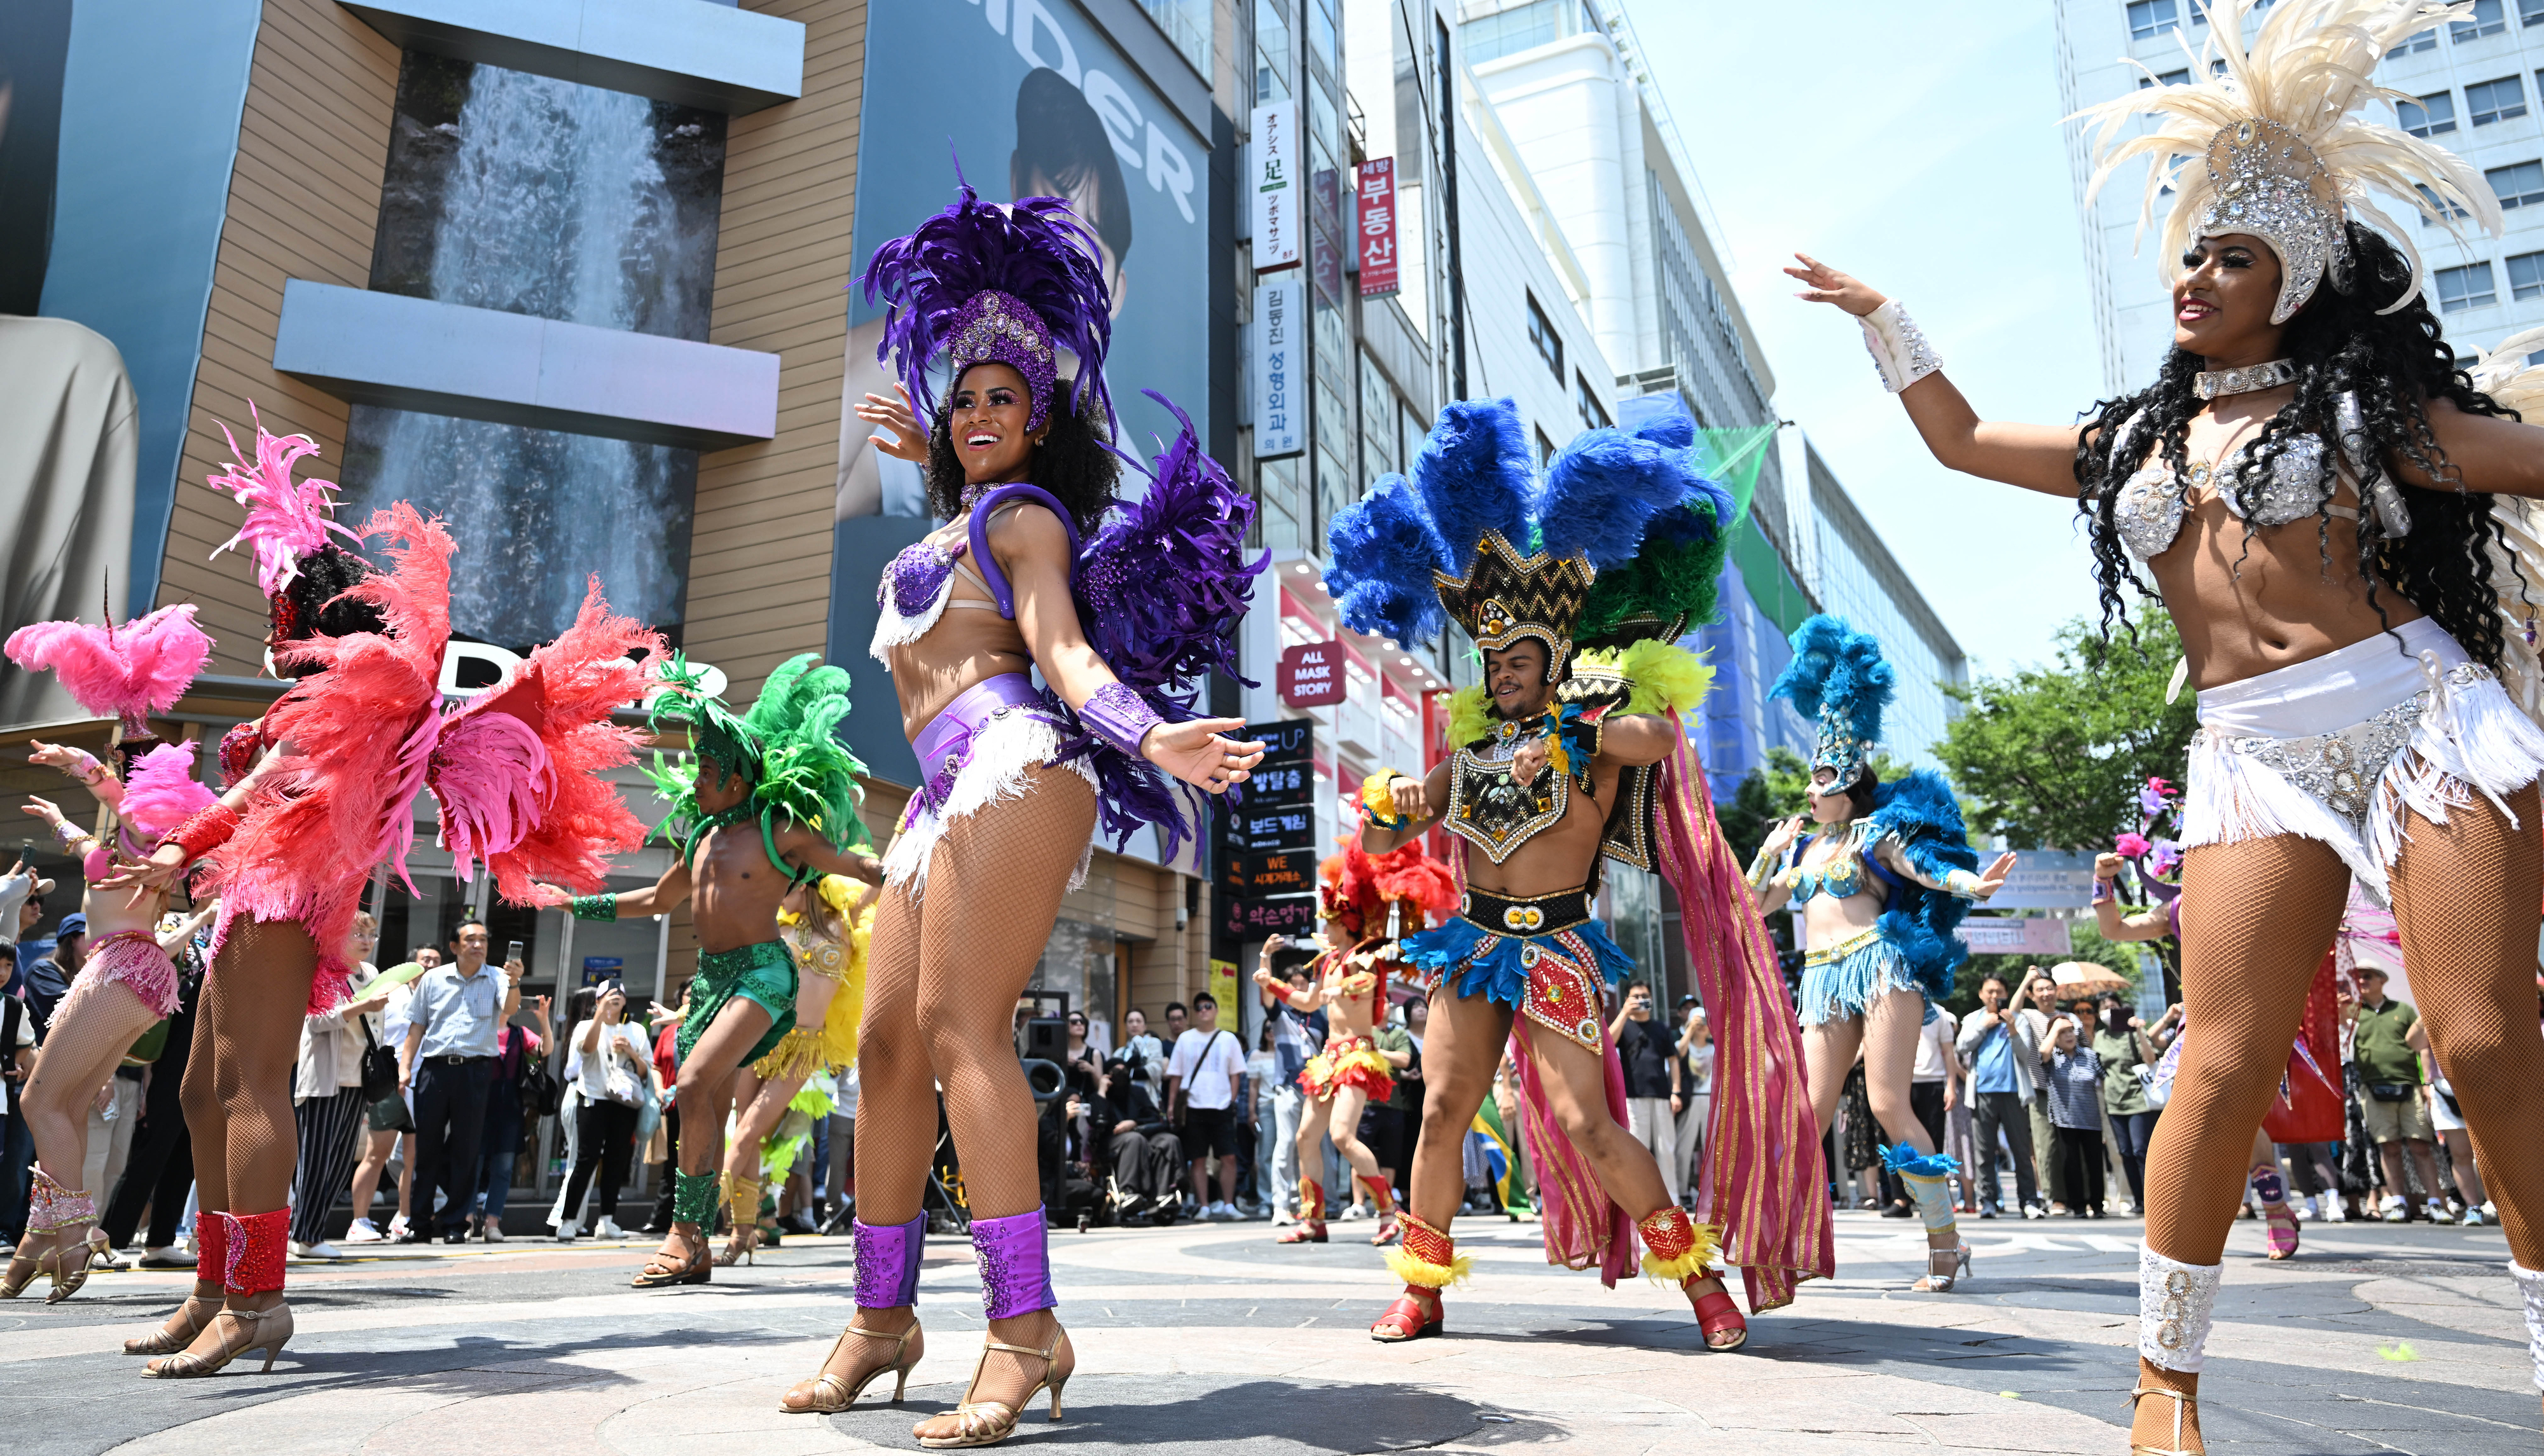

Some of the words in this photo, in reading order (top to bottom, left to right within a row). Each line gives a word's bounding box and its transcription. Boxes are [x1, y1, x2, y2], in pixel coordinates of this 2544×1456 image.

[1264, 159, 1283, 183] 足
[1362, 159, 1390, 175] 세방
[1361, 176, 1393, 266] 부동산
[1269, 290, 1283, 345] 김동진
[1269, 351, 1287, 431] 성형외과
[1301, 650, 1325, 664] ALL
[1295, 665, 1331, 681] MASK
[1294, 681, 1332, 697] STORY
[1252, 768, 1301, 792] 방탈출
[1250, 814, 1306, 835] 보드게임
[1267, 856, 1287, 870] WE
[1249, 903, 1310, 926] 약손명가
